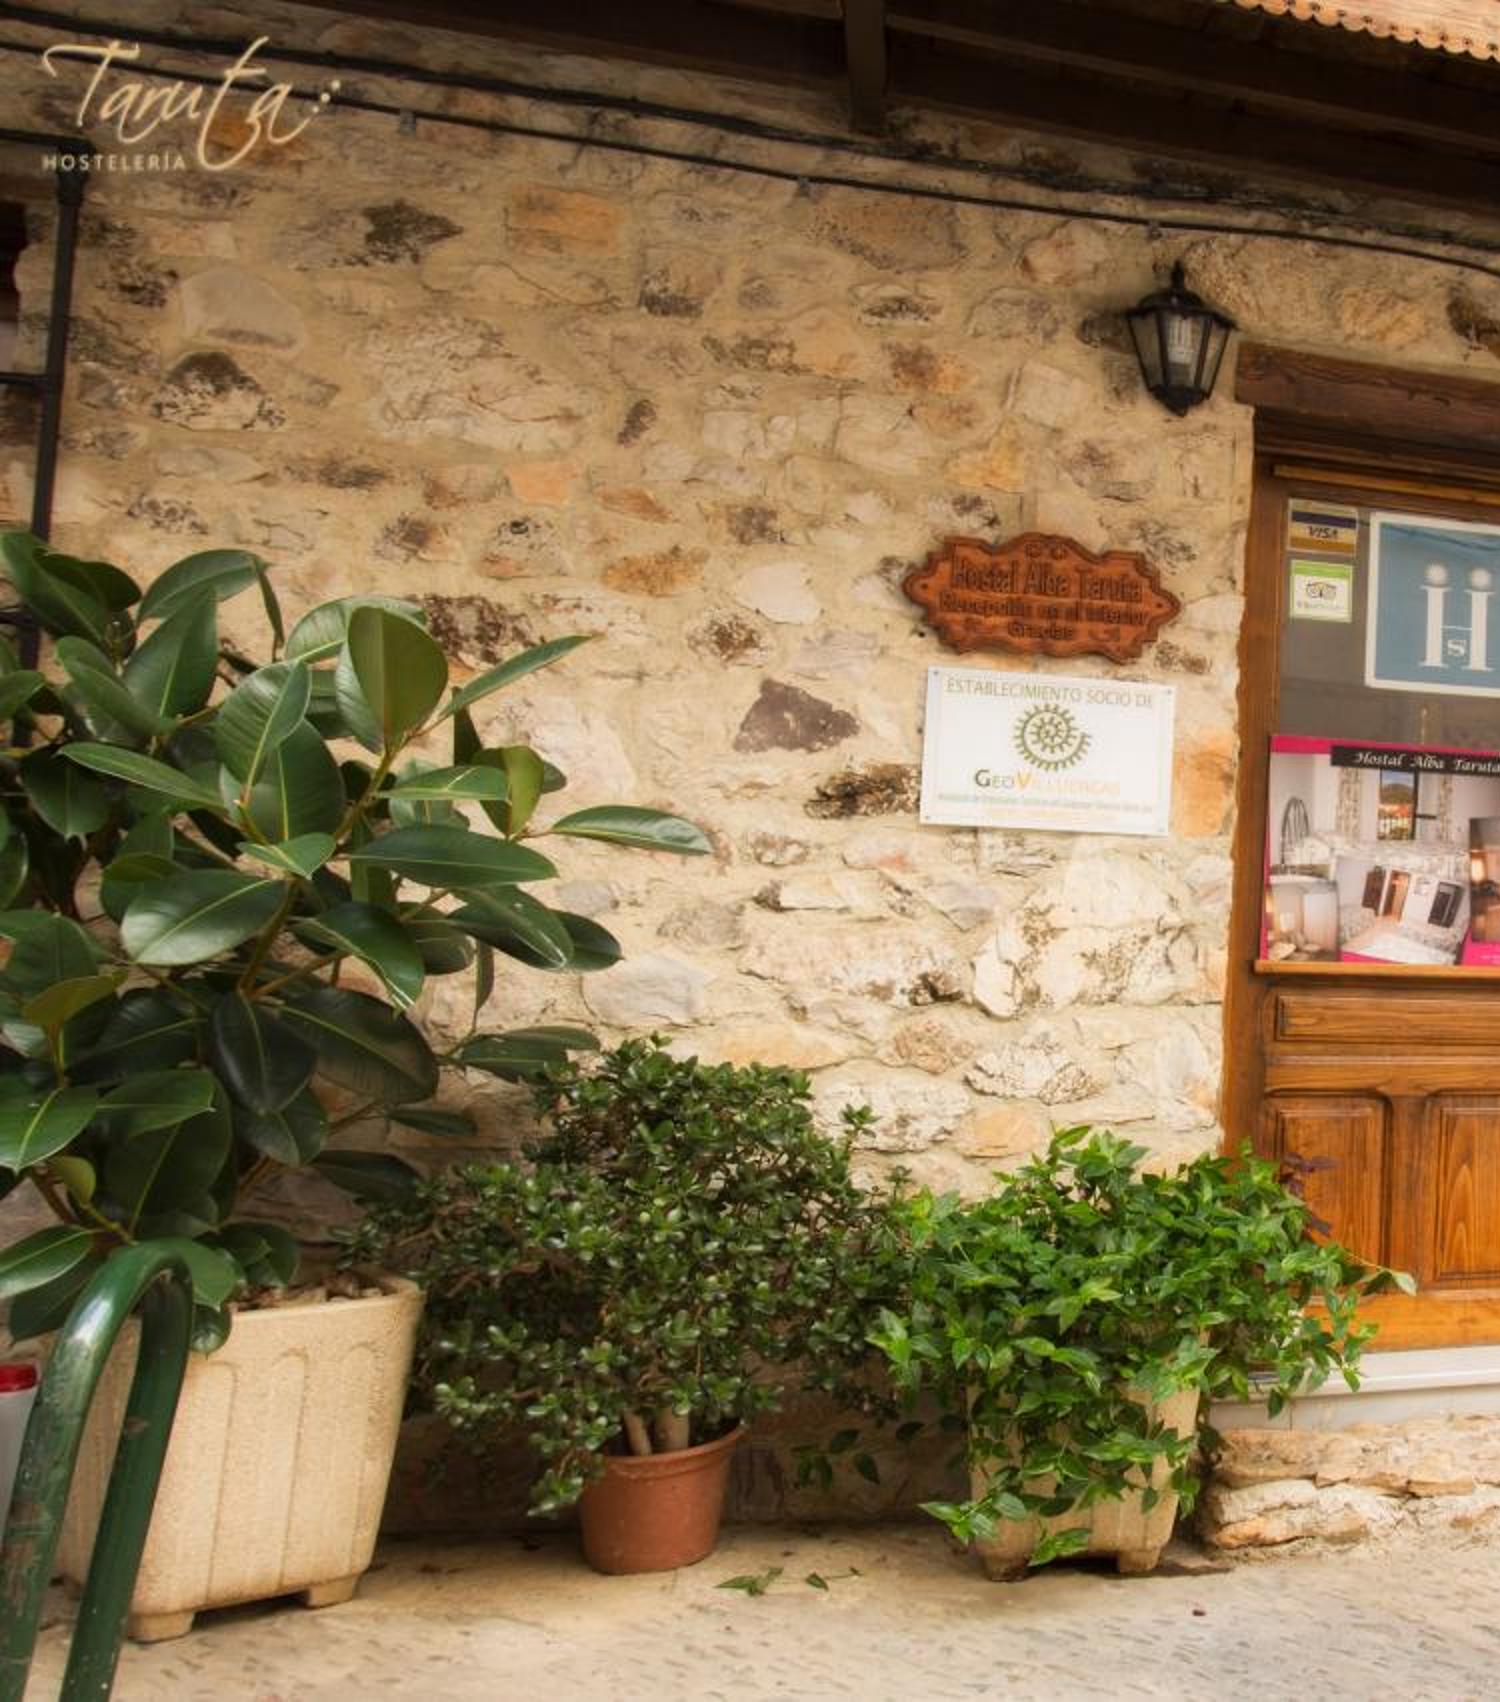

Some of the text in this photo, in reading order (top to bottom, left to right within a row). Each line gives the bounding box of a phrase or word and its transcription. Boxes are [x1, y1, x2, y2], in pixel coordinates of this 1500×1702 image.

[1307, 526, 1339, 539] VISA
[946, 676, 1082, 701] ESTABLECIMIENTO
[1087, 689, 1131, 707] SOCIO
[1353, 751, 1403, 766] Hostal
[1410, 754, 1445, 769] Alba
